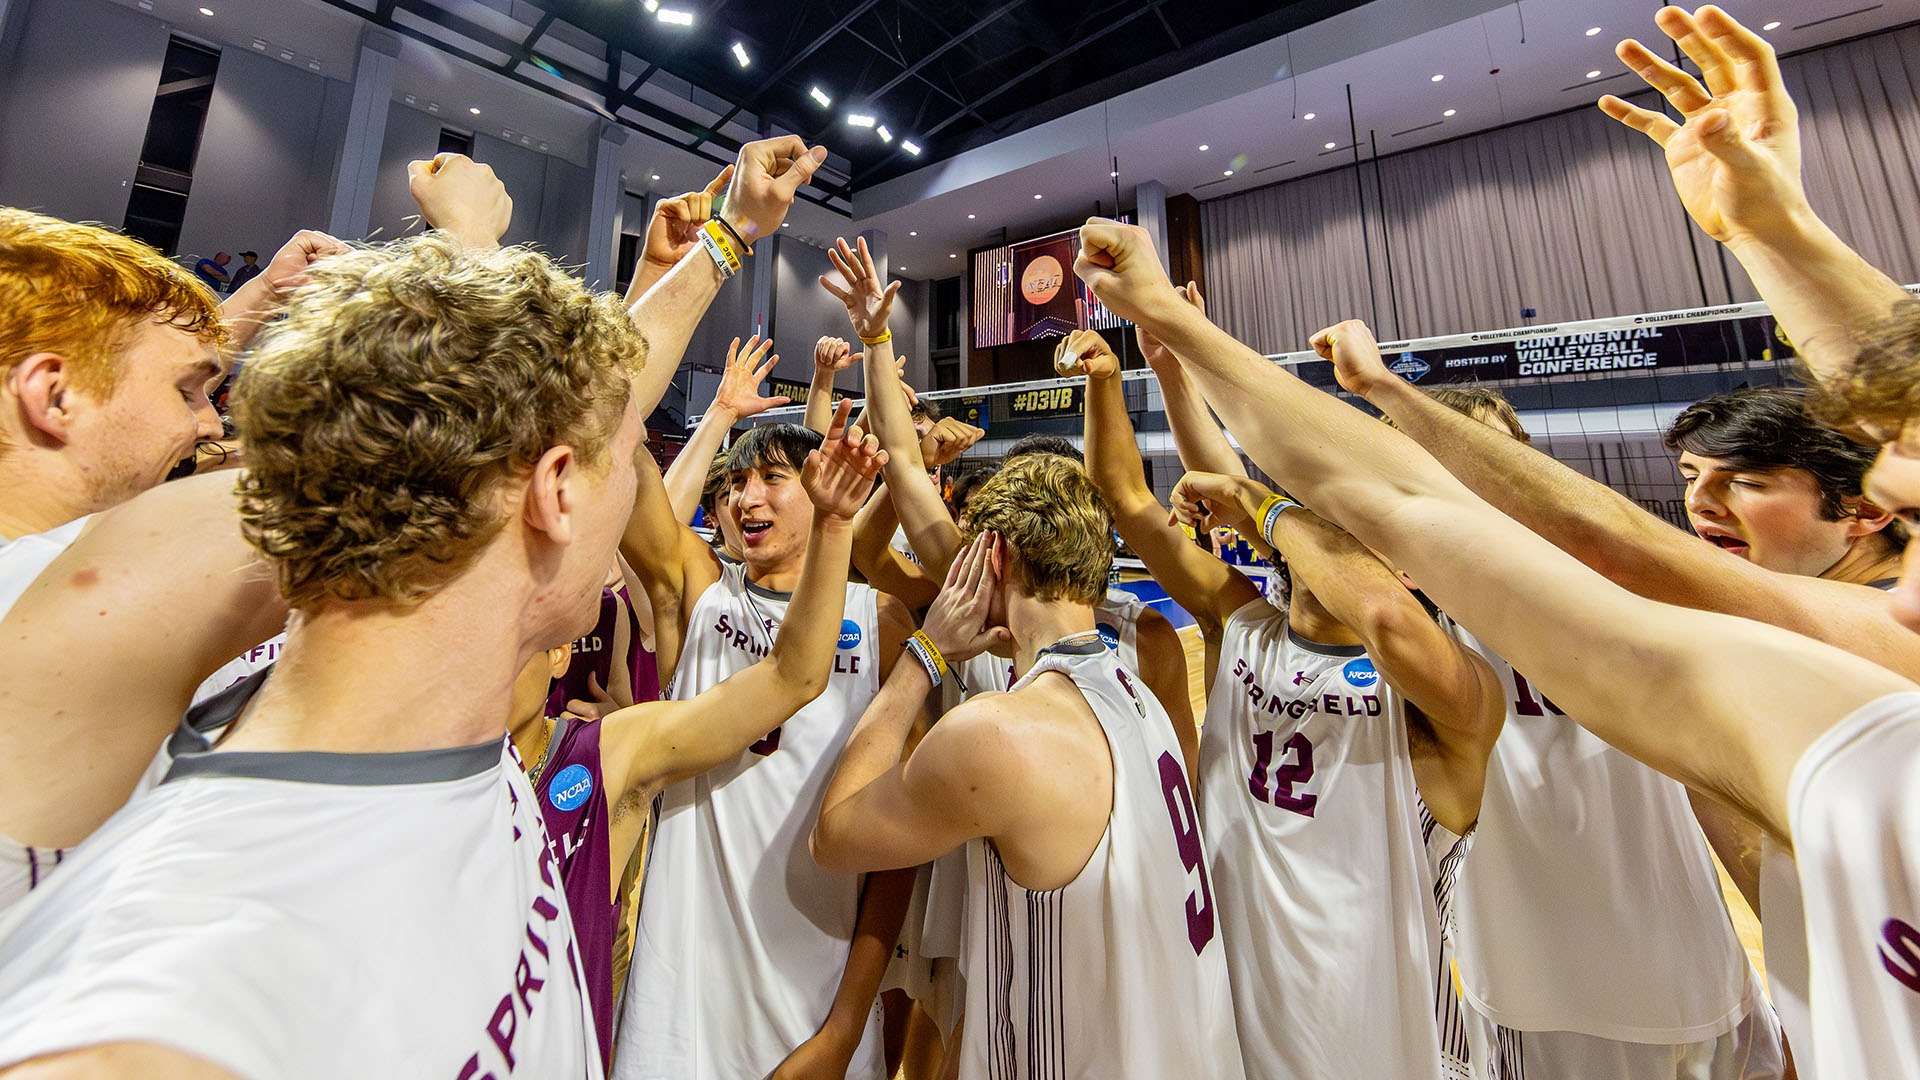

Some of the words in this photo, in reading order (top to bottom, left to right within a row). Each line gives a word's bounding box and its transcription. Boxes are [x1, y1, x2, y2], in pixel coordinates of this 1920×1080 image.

[1026, 274, 1061, 294] NCAA
[1645, 313, 1686, 323] VOLLEYBALL
[1686, 307, 1742, 318] CHAMPIONSHIP
[1480, 331, 1512, 340] VOLLEYBALL
[1513, 327, 1558, 336] CHAMPIONSHIP
[1515, 327, 1663, 350] CONTINENTAL
[1446, 358, 1488, 368] HOSTED
[1491, 355, 1508, 364] BY
[1516, 340, 1644, 363] VOLLEYBALL
[1519, 352, 1658, 376] CONFERENCE
[1014, 388, 1072, 412] #D3VB
[838, 633, 860, 642] CAA
[1100, 634, 1118, 645] CAA
[1348, 670, 1379, 680] NCAA
[1233, 658, 1382, 720] SPRNGELD
[1248, 730, 1318, 818] 12
[556, 778, 591, 804] NCAA
[1157, 750, 1214, 957] 9
